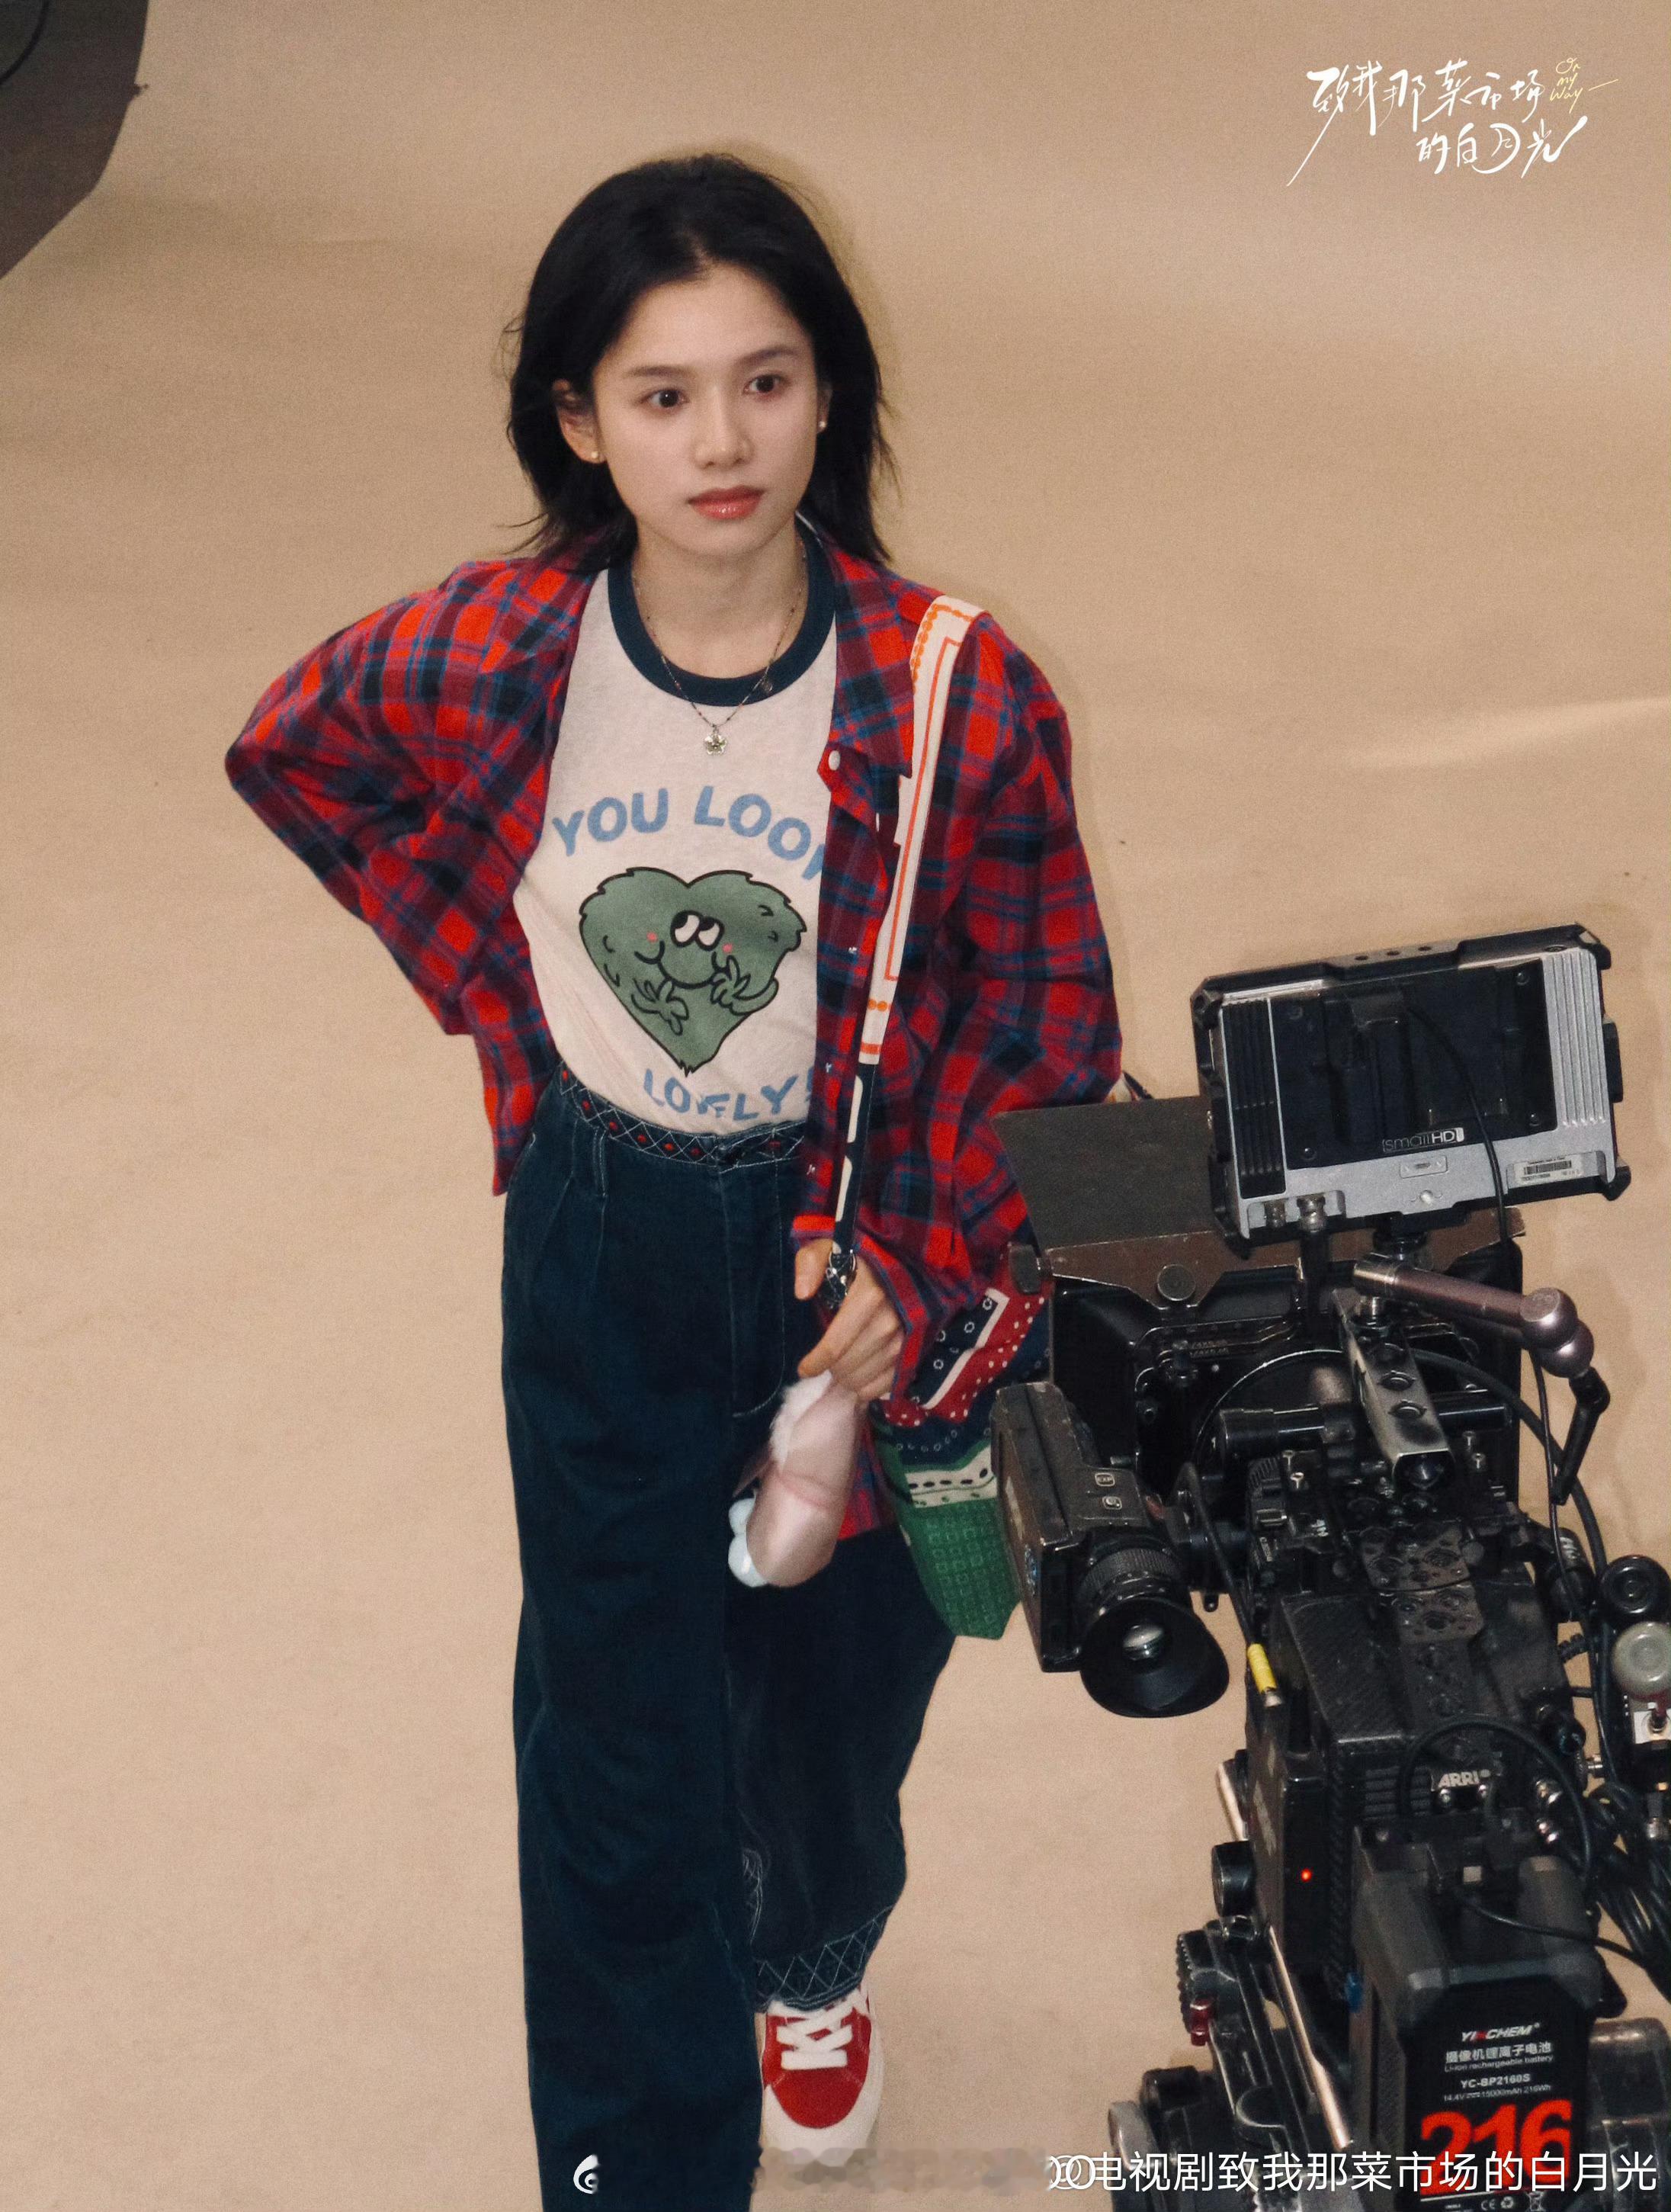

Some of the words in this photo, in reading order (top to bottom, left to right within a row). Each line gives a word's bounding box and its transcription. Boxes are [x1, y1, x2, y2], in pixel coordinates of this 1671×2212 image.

[552, 788, 669, 856] YOU
[1438, 1770, 1480, 1789] ARRI
[1420, 2098, 1572, 2195] 216
